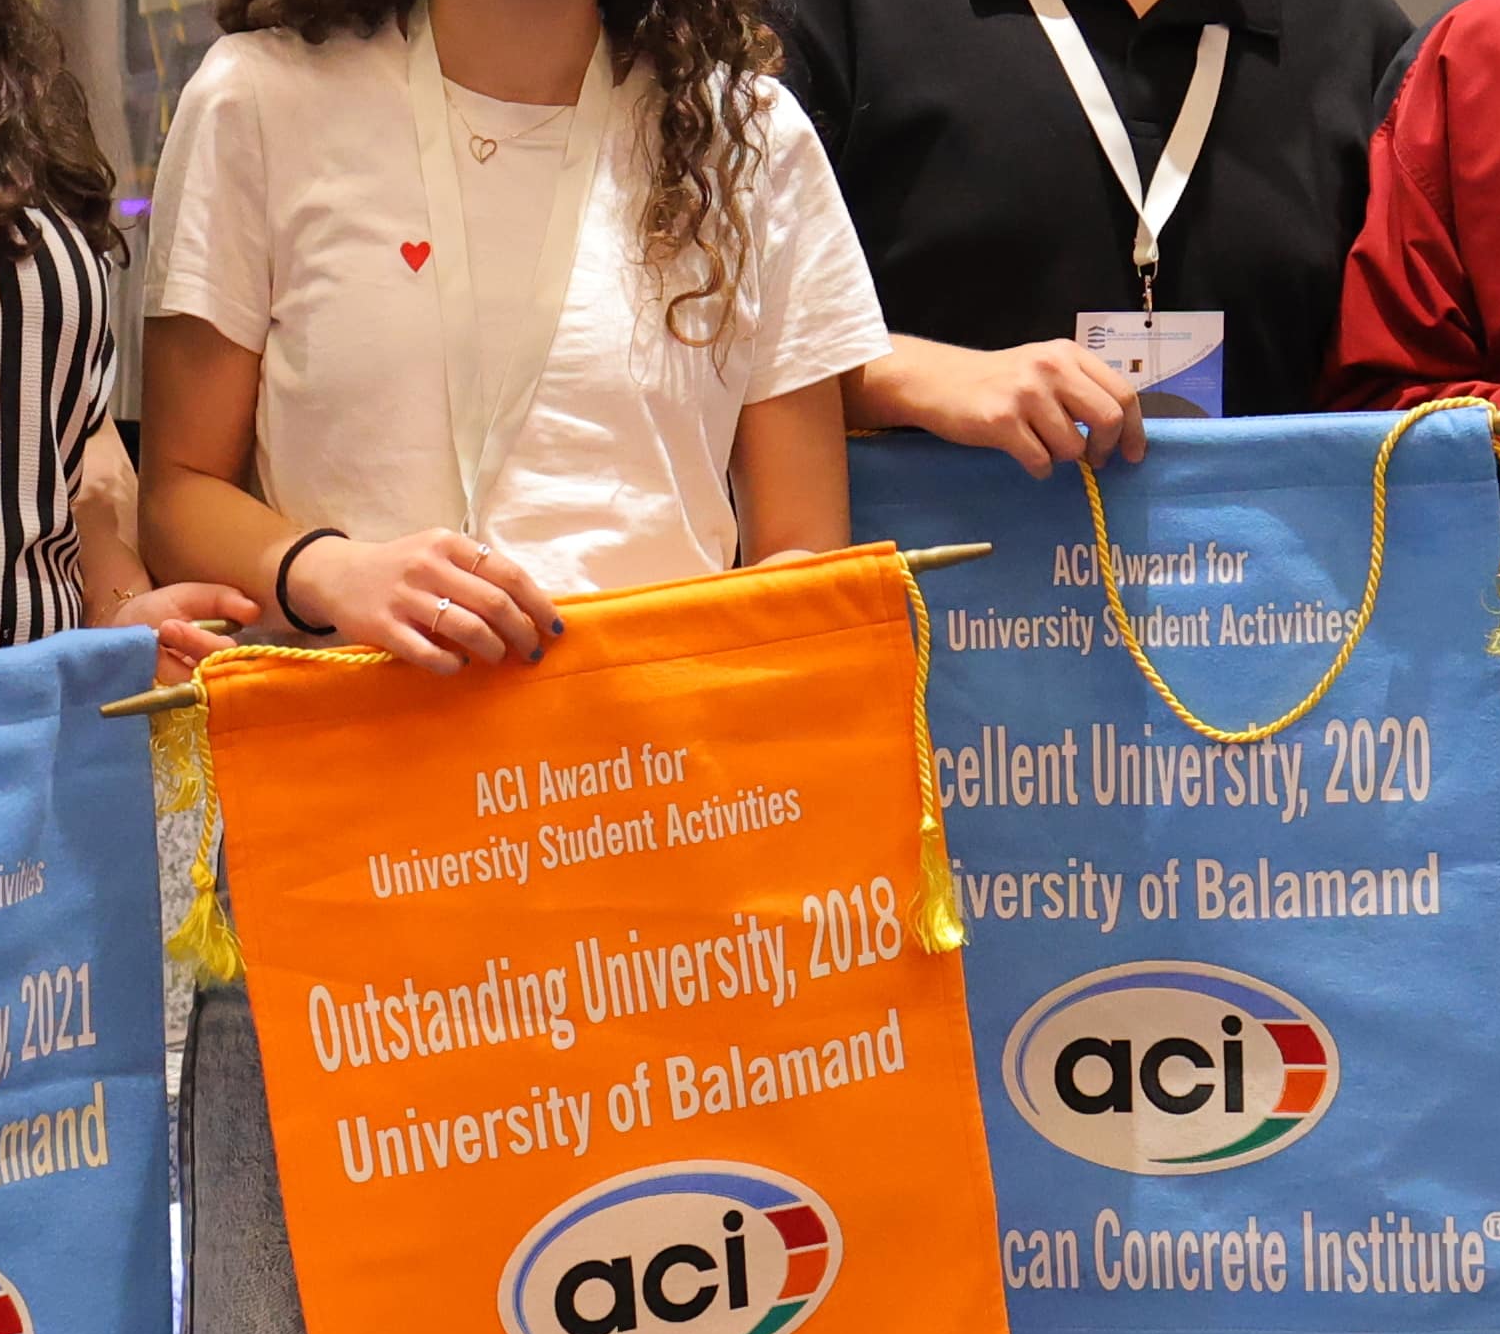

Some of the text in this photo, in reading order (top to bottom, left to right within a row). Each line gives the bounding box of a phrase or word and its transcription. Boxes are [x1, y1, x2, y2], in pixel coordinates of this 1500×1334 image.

[1053, 541, 1249, 587] ACI Award for
[947, 605, 1094, 655] University
[1103, 604, 1211, 648] Sudent
[474, 741, 688, 817] ACI Award for
[934, 716, 1431, 823] cellent University, 2020
[368, 786, 802, 899] University Student Activities
[952, 851, 1441, 933] iversity of Balamand
[21, 962, 97, 1062] 2021
[308, 876, 902, 1072] Outstanding University, 2018
[336, 1007, 905, 1183] University of Balamand
[1053, 1015, 1245, 1116] aci
[1096, 1208, 1288, 1293] Concrete
